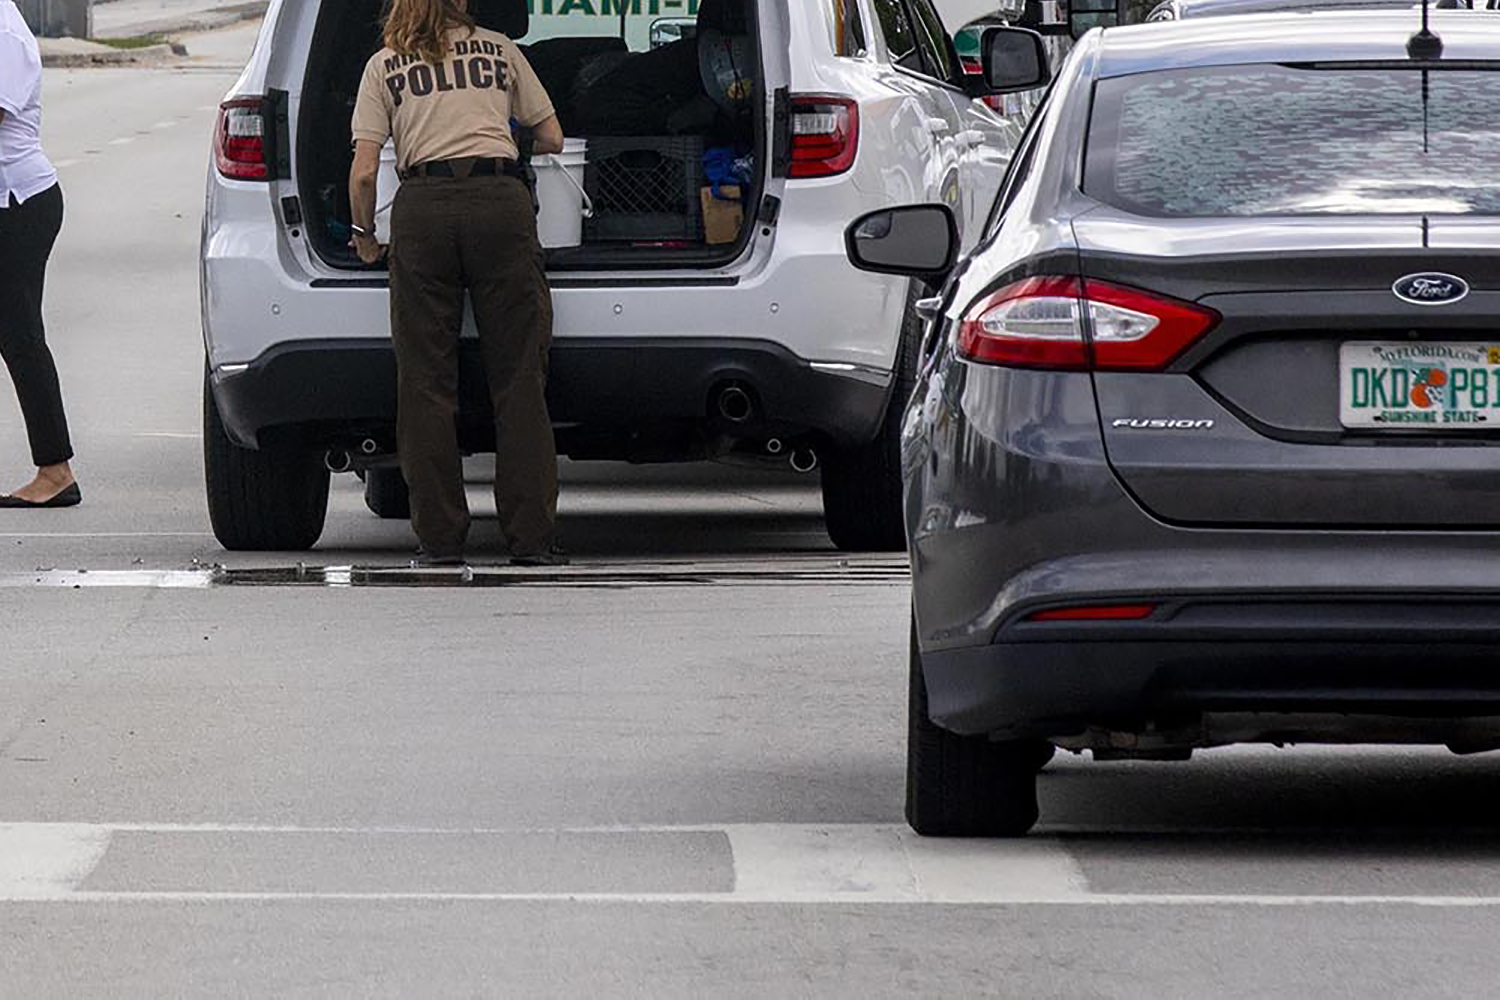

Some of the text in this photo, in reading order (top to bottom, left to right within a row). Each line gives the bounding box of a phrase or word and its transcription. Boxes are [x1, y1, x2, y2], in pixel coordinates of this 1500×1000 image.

[386, 56, 508, 107] POLICE
[1408, 278, 1452, 297] Ford
[1351, 367, 1409, 408] DKD
[1112, 418, 1214, 428] FUSION
[1380, 411, 1478, 423] SUNSHINE STATE
